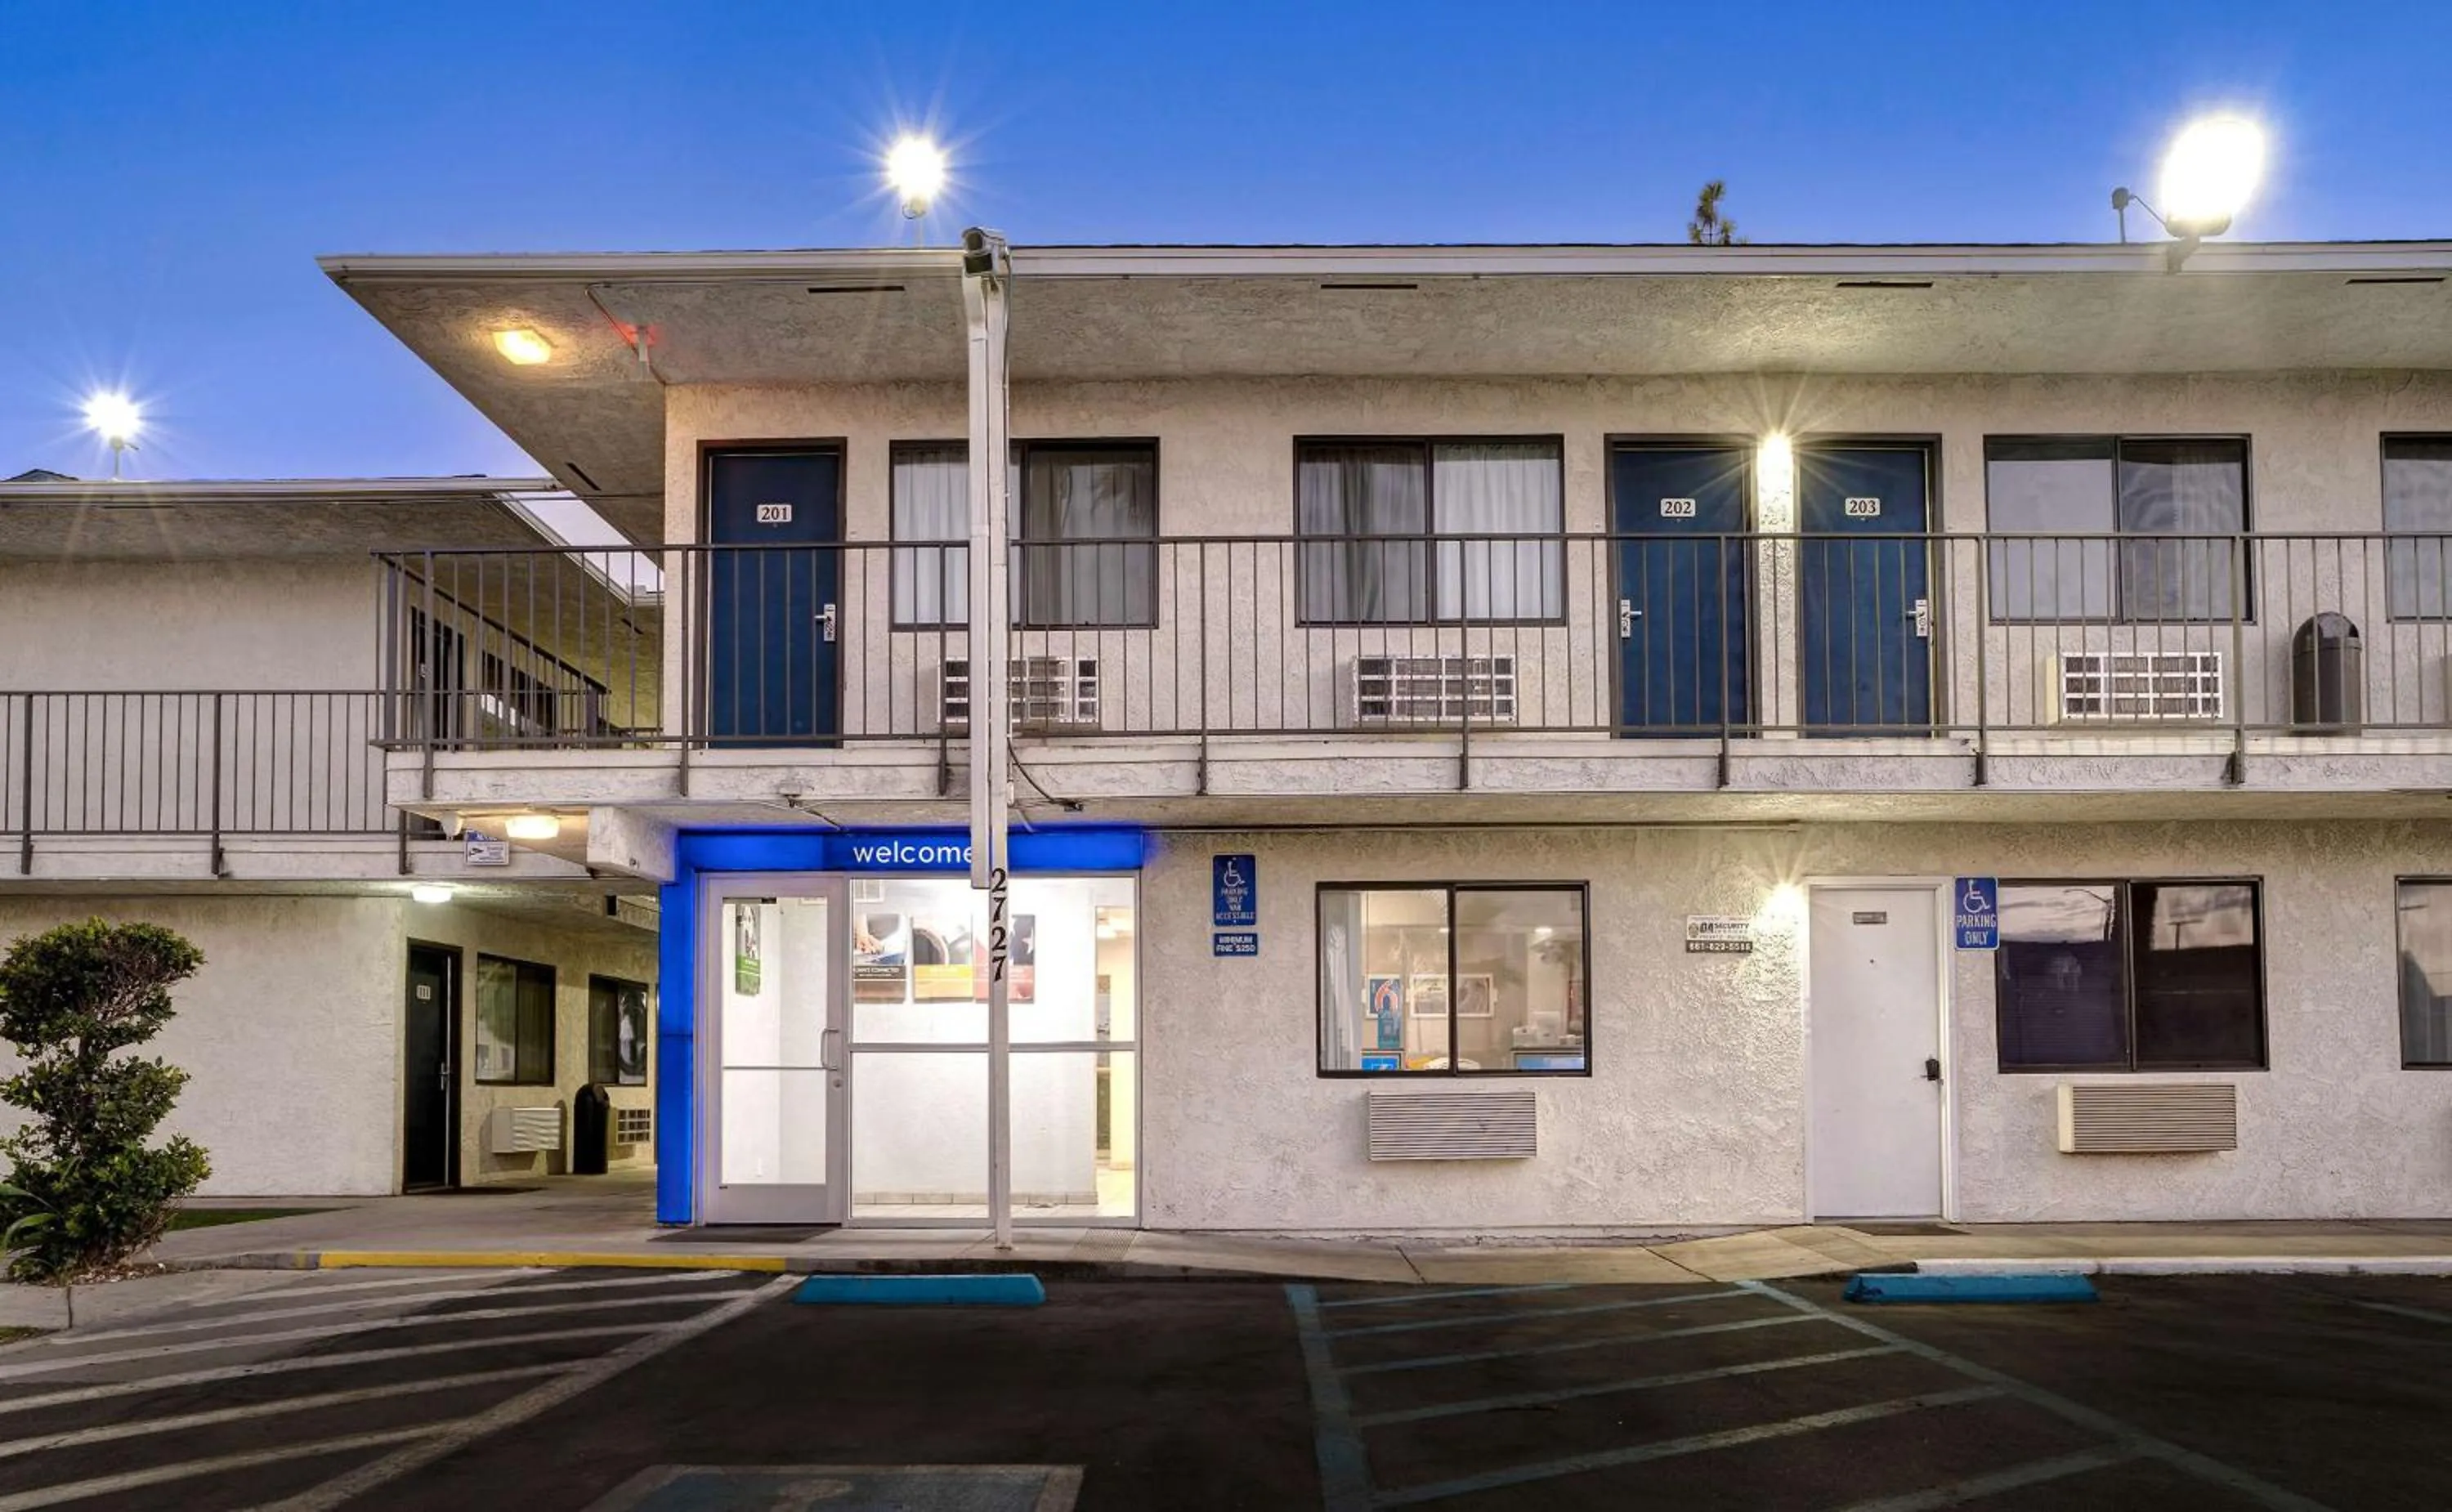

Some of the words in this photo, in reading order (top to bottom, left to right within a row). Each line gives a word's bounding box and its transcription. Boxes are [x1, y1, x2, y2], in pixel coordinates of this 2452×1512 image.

[1665, 501, 1691, 514] 202
[1850, 500, 1876, 513] 203
[761, 507, 787, 520] 201
[991, 868, 1007, 982] 2727
[1957, 914, 1997, 928] PARKING
[1964, 931, 1989, 945] ONLY
